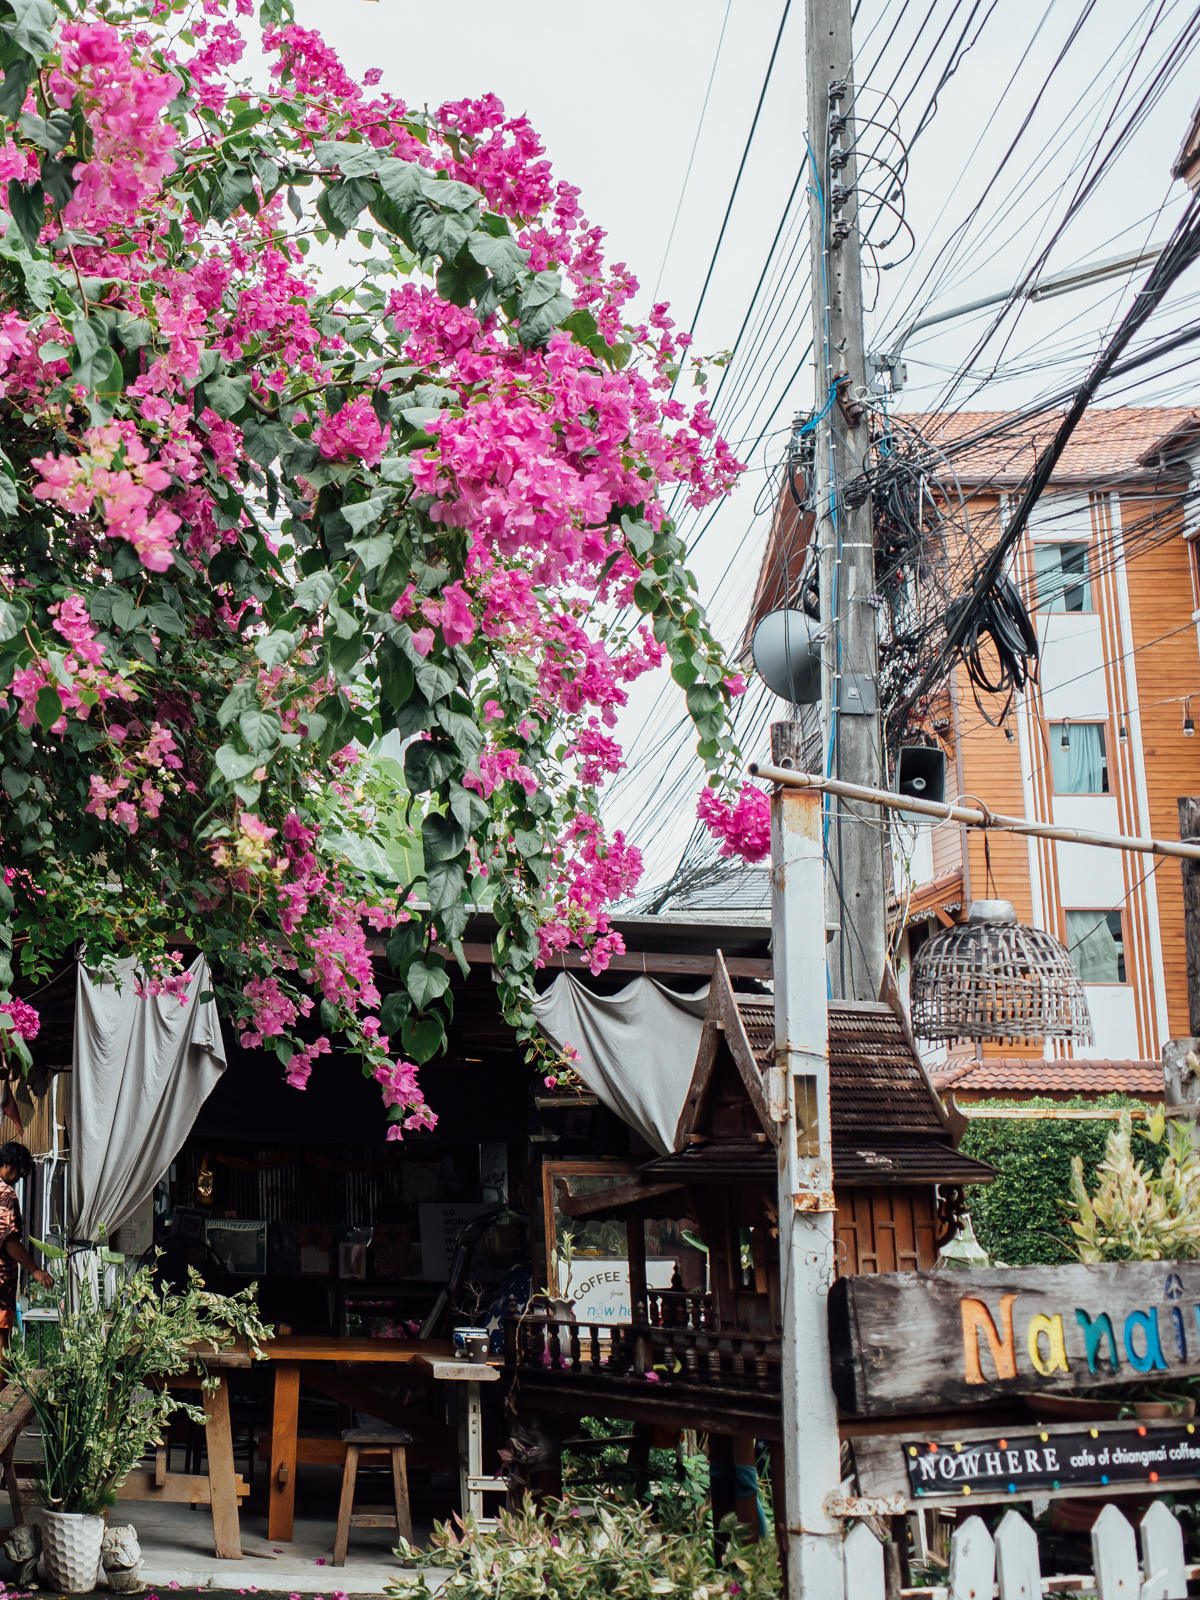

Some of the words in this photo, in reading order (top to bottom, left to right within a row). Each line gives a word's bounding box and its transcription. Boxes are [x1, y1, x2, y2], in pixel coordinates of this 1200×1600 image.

[573, 1271, 621, 1300] COFFEE
[960, 1271, 1200, 1385] Nanai
[918, 1447, 1060, 1481] NOWHERE
[1069, 1450, 1096, 1468] cafe
[1097, 1448, 1110, 1466] of
[1114, 1445, 1168, 1468] chiangmai
